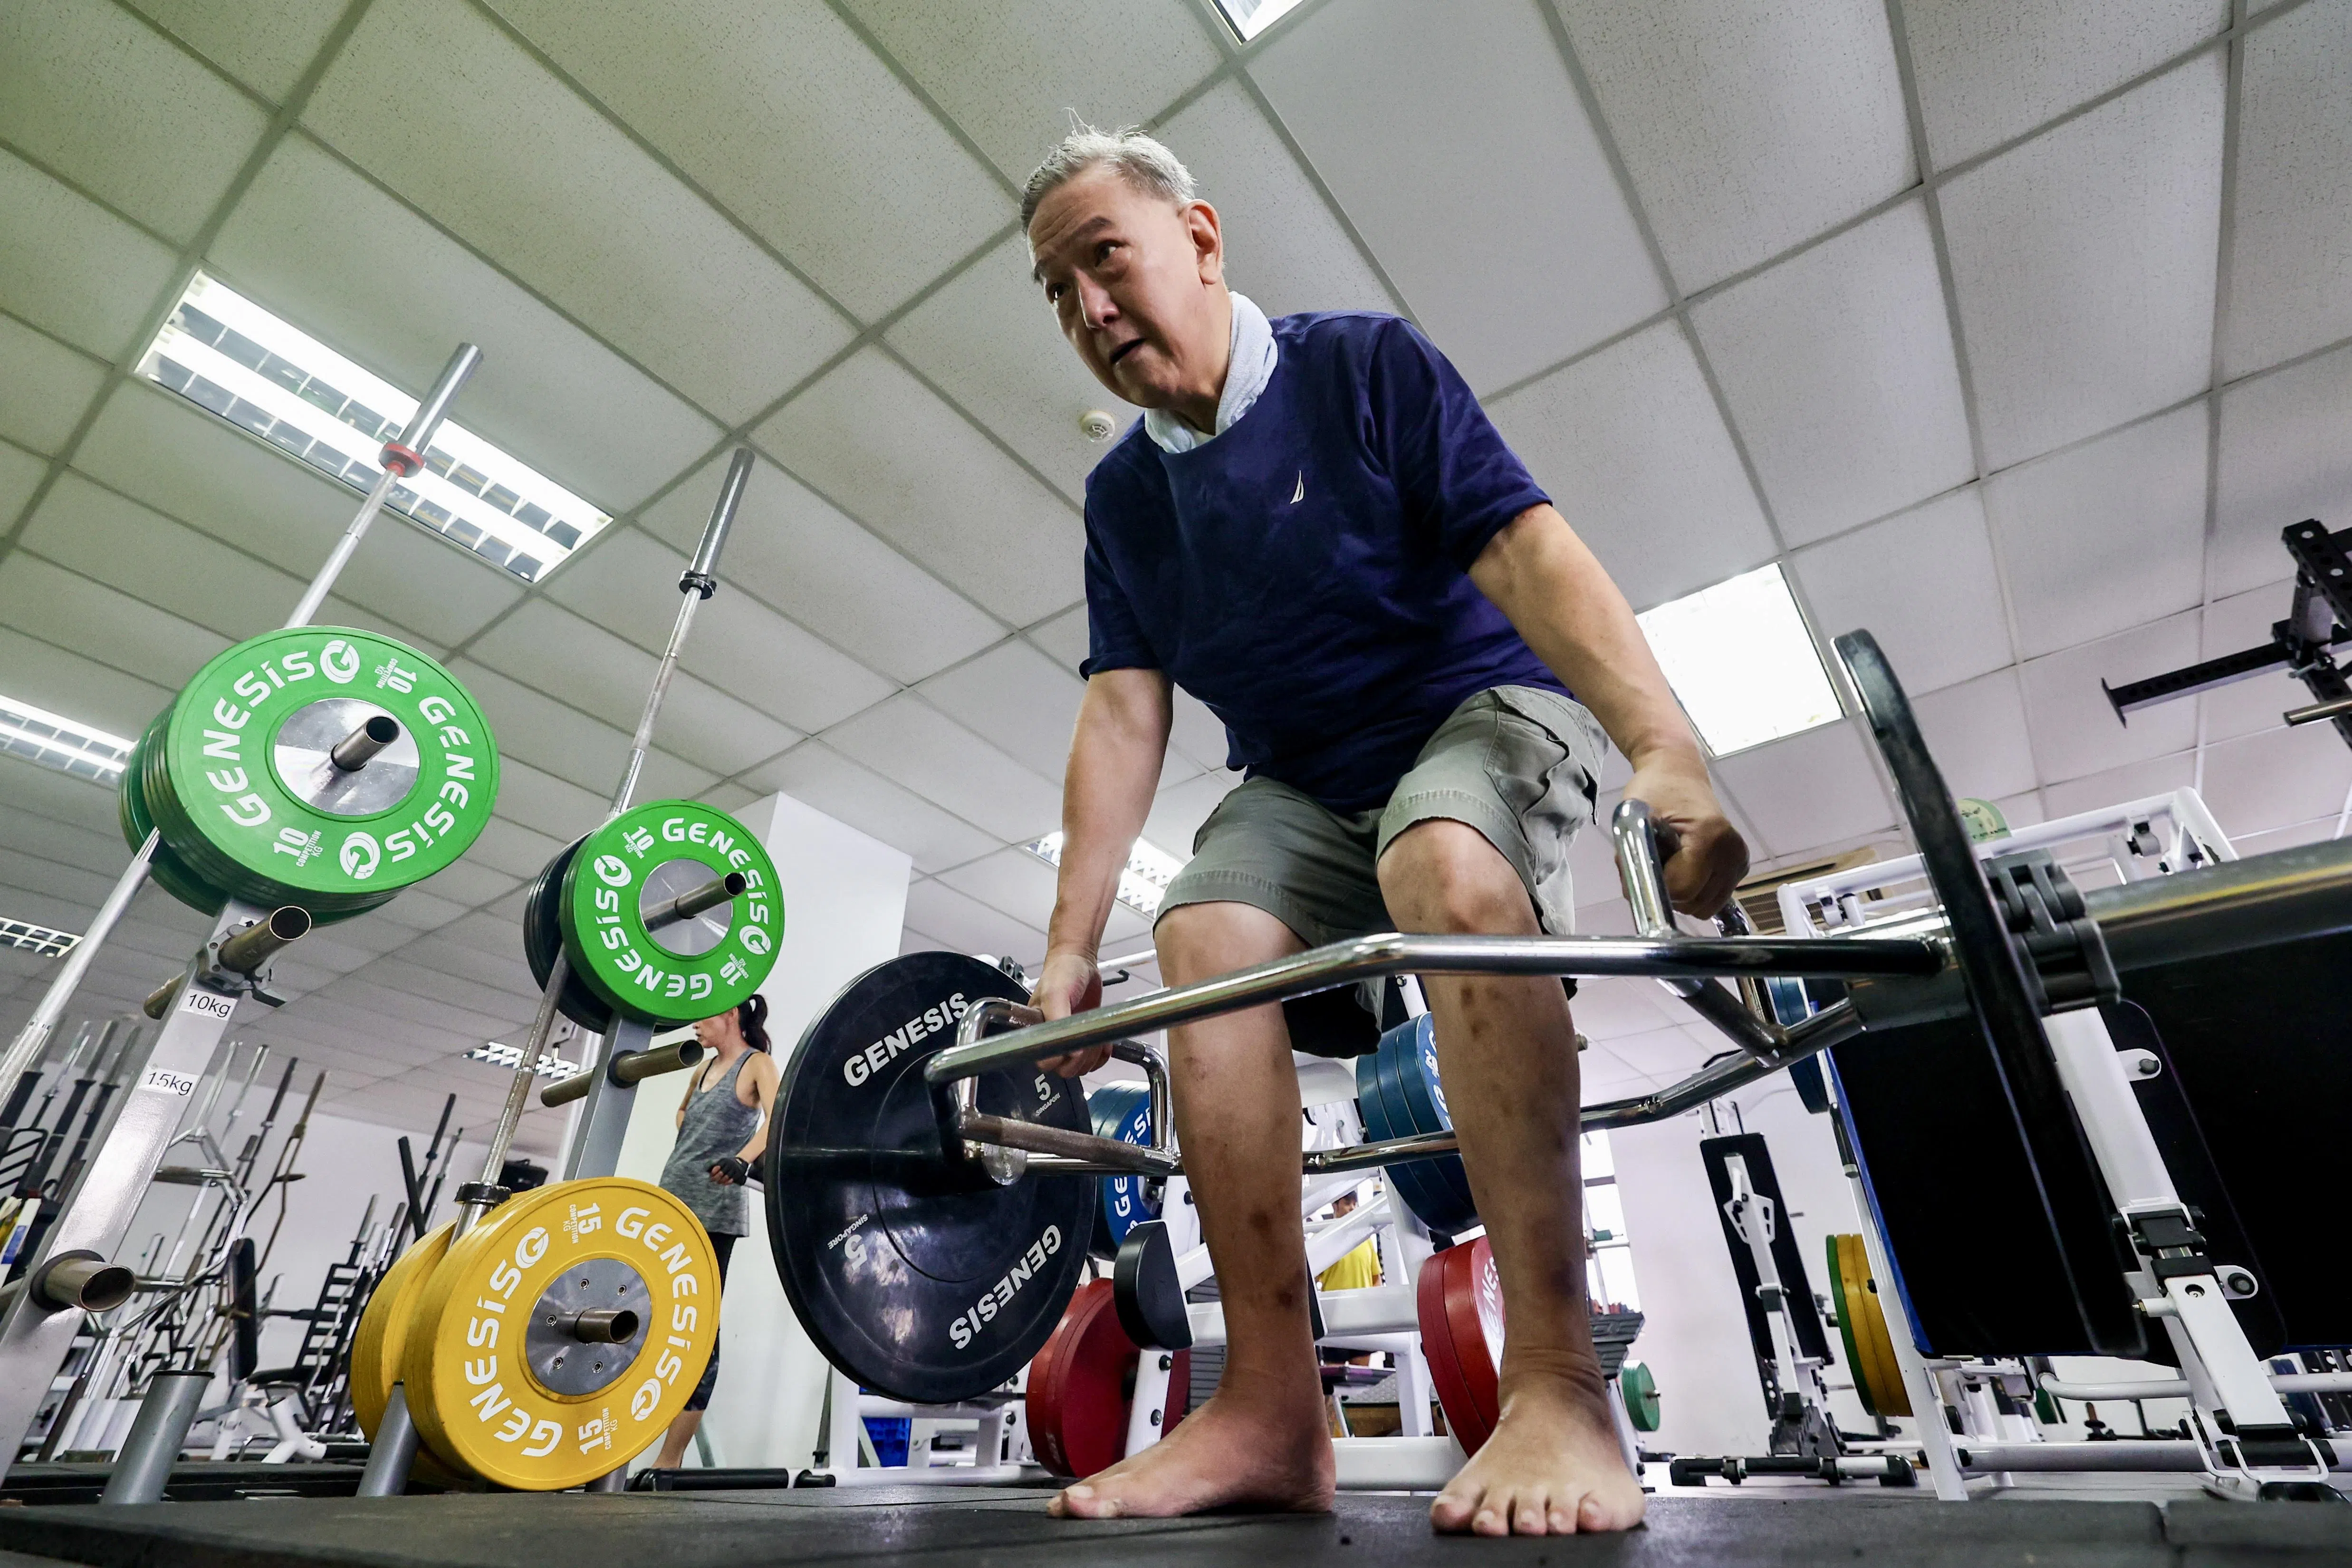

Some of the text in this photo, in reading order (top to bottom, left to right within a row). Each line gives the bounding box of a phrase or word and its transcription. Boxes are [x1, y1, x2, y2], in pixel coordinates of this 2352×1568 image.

[387, 666, 417, 694] 10
[203, 651, 316, 827] GENESIS
[384, 696, 475, 863] GENESIS
[273, 827, 309, 857] 10
[296, 830, 322, 867] COMPETITION
[311, 846, 323, 857] KG
[631, 826, 654, 850] 10
[662, 818, 768, 924] GENESIS
[595, 887, 712, 1000] GENESIS
[720, 962, 741, 986] 10
[189, 994, 231, 1018] 10kg
[844, 992, 969, 1087] GENESIS
[1035, 1073, 1051, 1101] 5
[577, 1202, 601, 1234] 15
[827, 1214, 868, 1250] SINGAPORE
[845, 1234, 867, 1270] 5
[615, 1207, 698, 1386] GENESIS
[950, 1225, 1061, 1349] GENESIS
[465, 1266, 562, 1457] GENESIS
[578, 1419, 604, 1455] 15
